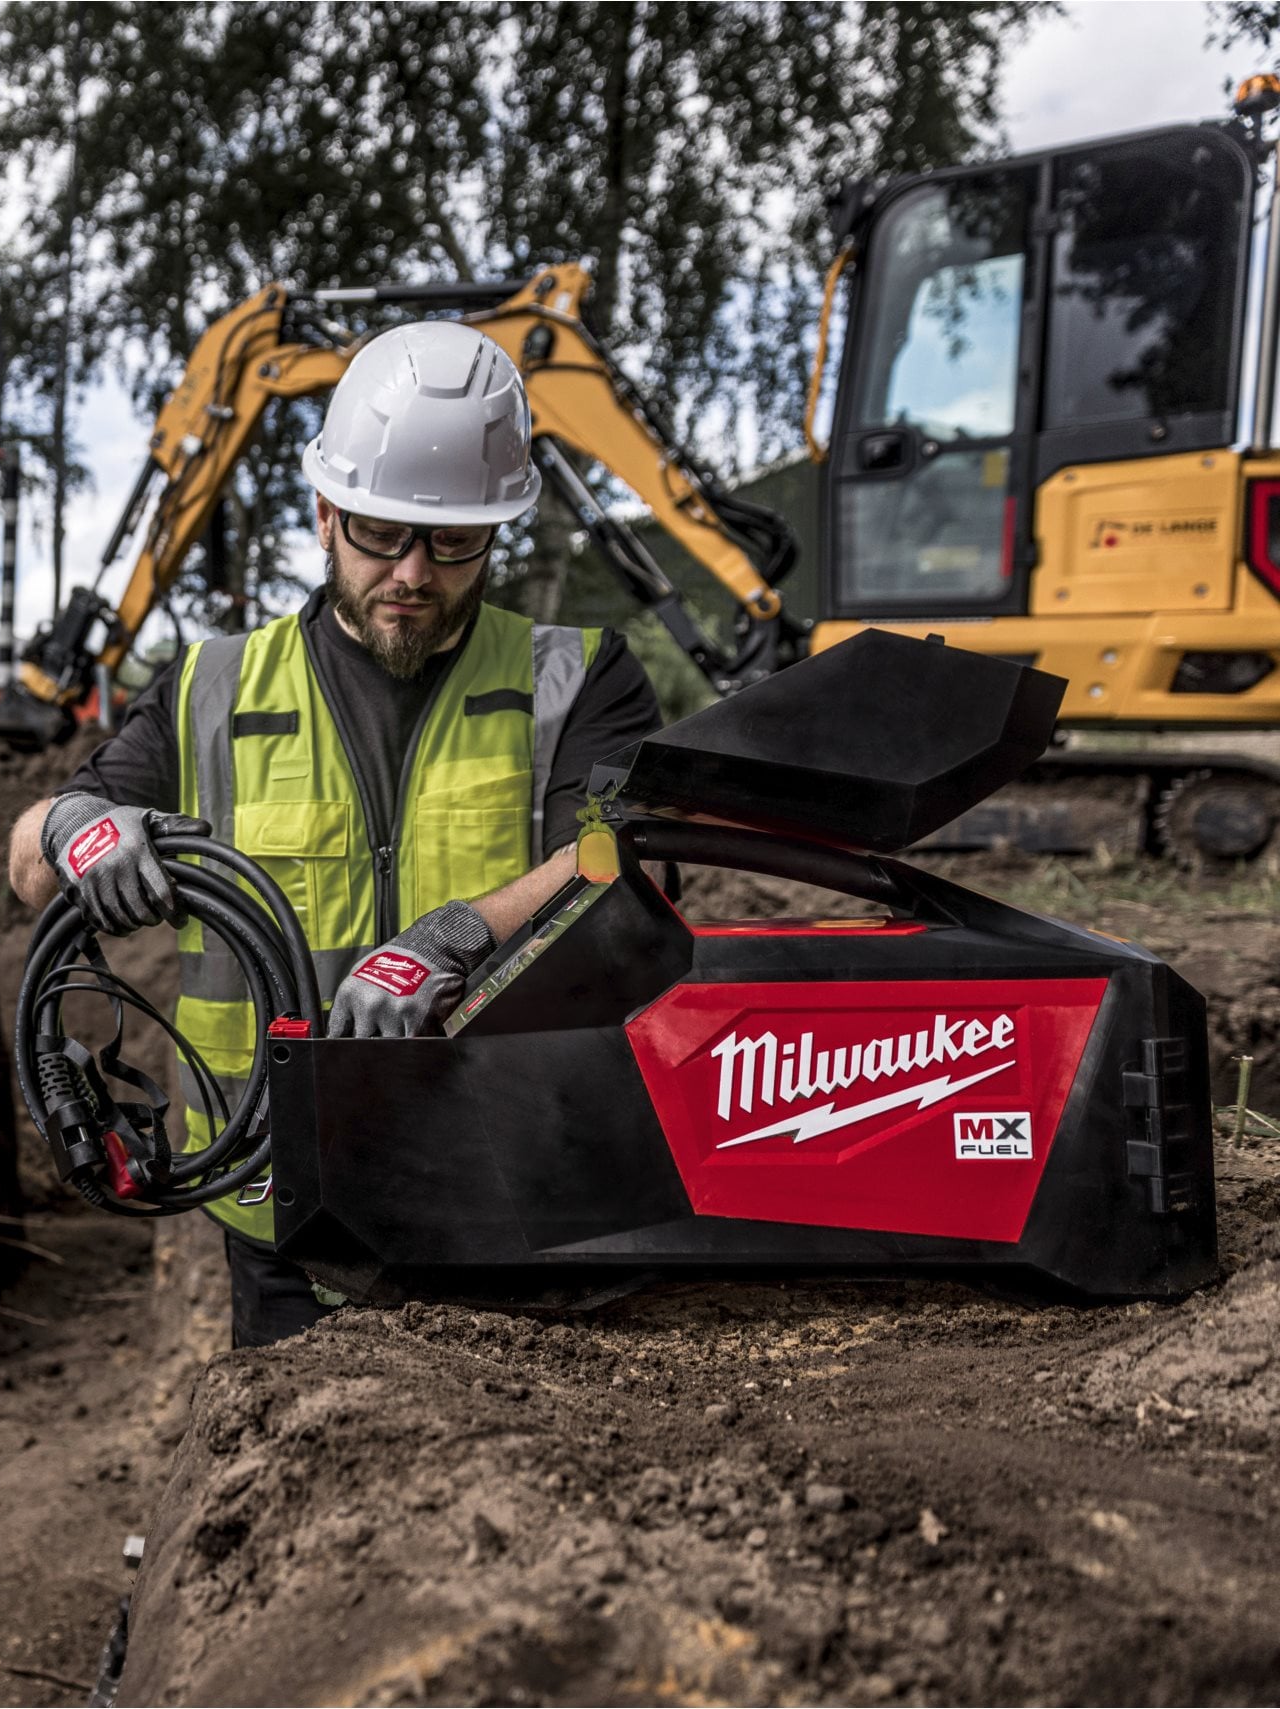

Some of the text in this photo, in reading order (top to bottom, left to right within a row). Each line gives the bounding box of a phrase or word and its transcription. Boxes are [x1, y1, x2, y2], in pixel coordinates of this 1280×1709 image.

[711, 1014, 1015, 1121] Milwaukee
[959, 1118, 1027, 1140] MX
[960, 1144, 1029, 1156] FUEL
